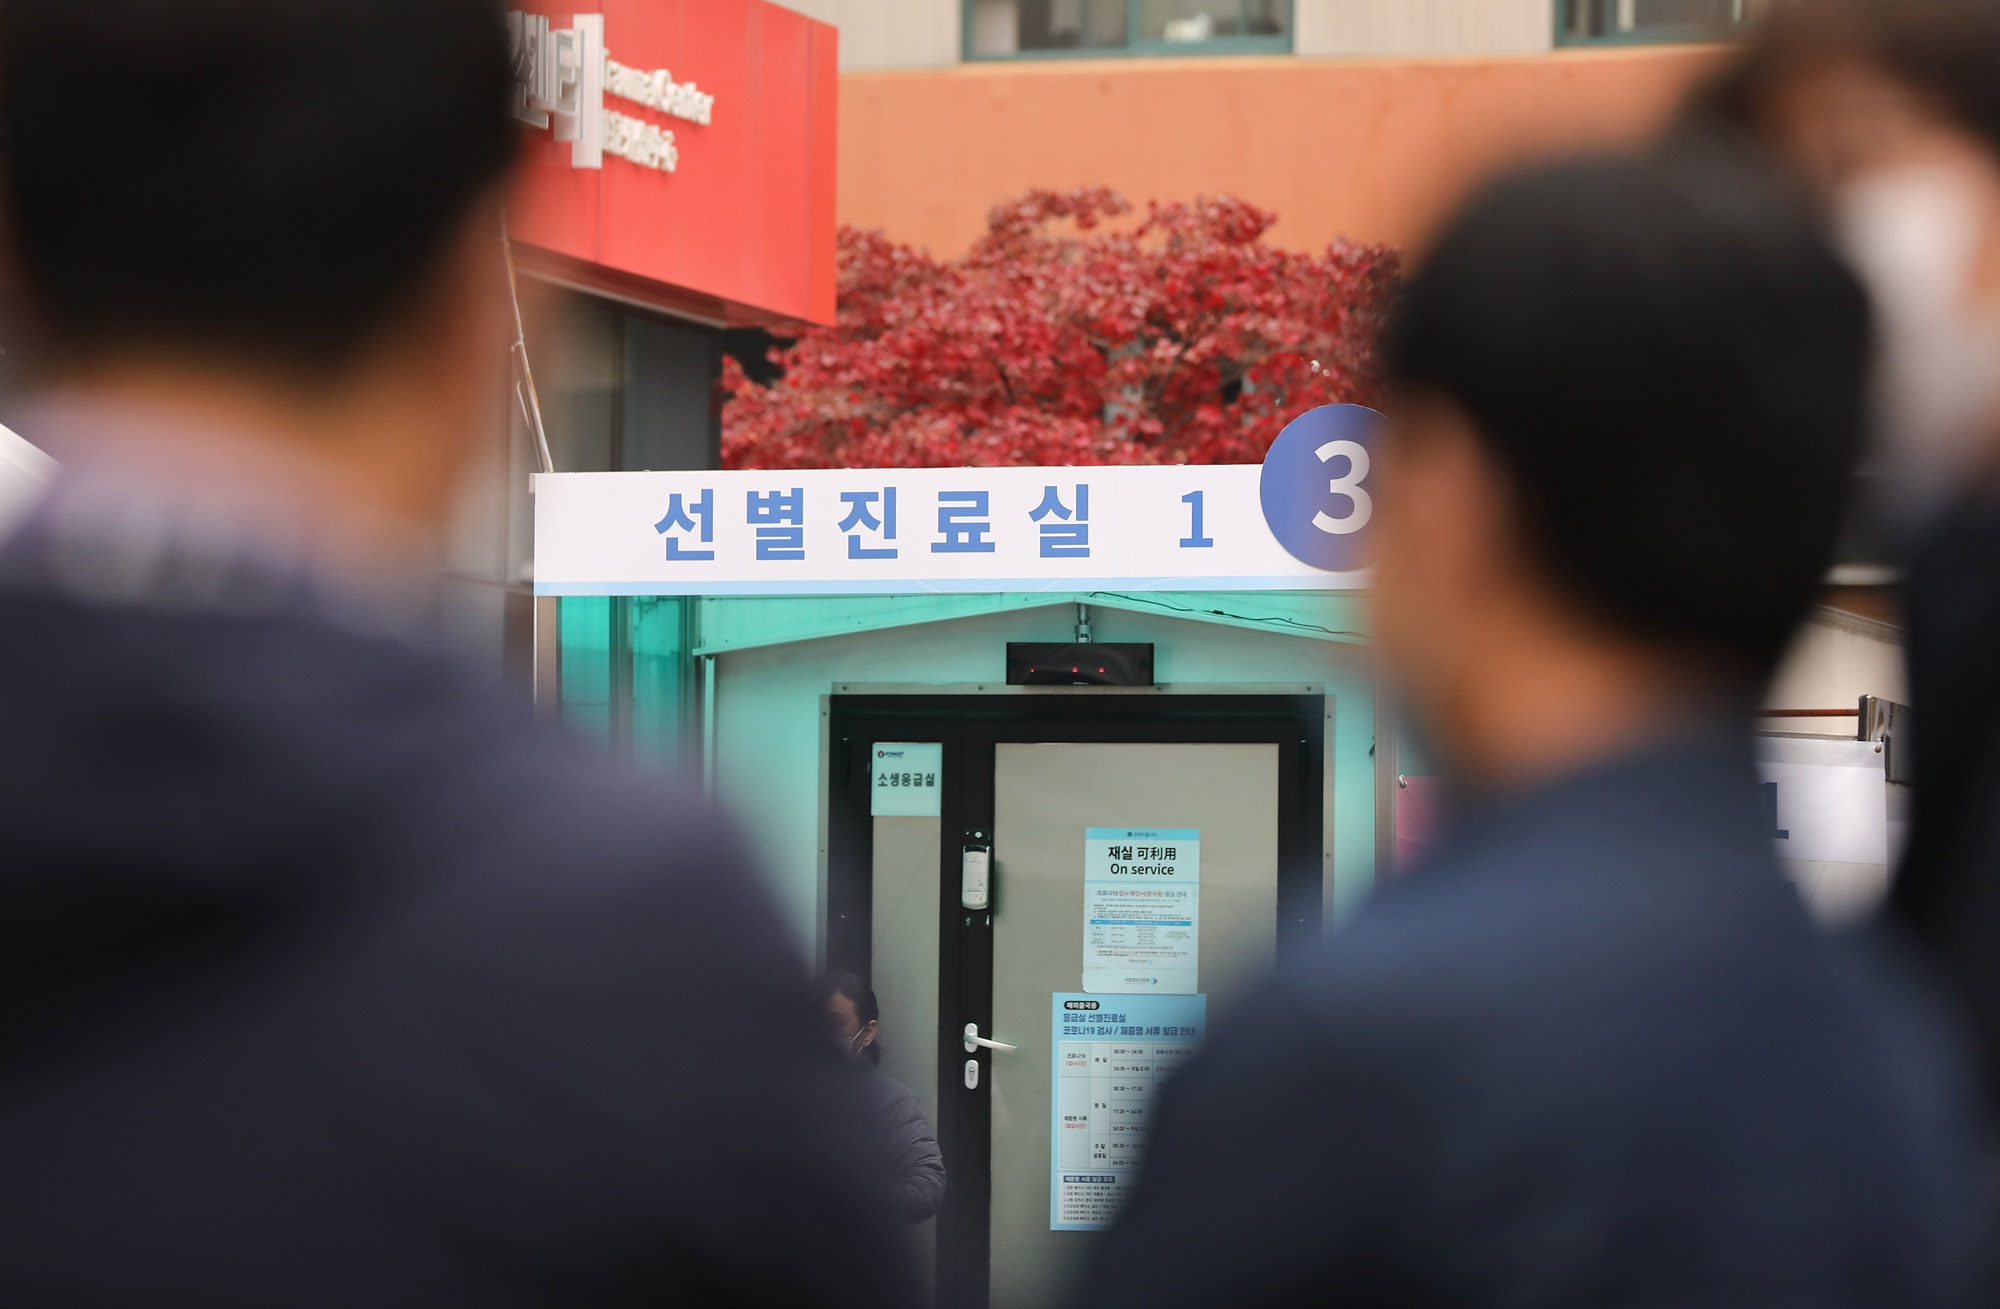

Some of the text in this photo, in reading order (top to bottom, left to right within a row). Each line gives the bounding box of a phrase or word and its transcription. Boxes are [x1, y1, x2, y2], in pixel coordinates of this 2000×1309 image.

[1311, 439, 1373, 535] 3
[653, 483, 1214, 561] 선별진료실 1
[877, 772, 935, 787] 소생응급실
[1108, 845, 1177, 861] 재실 可利用
[1110, 863, 1175, 875] On service
[1063, 1013, 1127, 1024] 응급실 선별진료실
[1063, 1026, 1095, 1036] 코로나19
